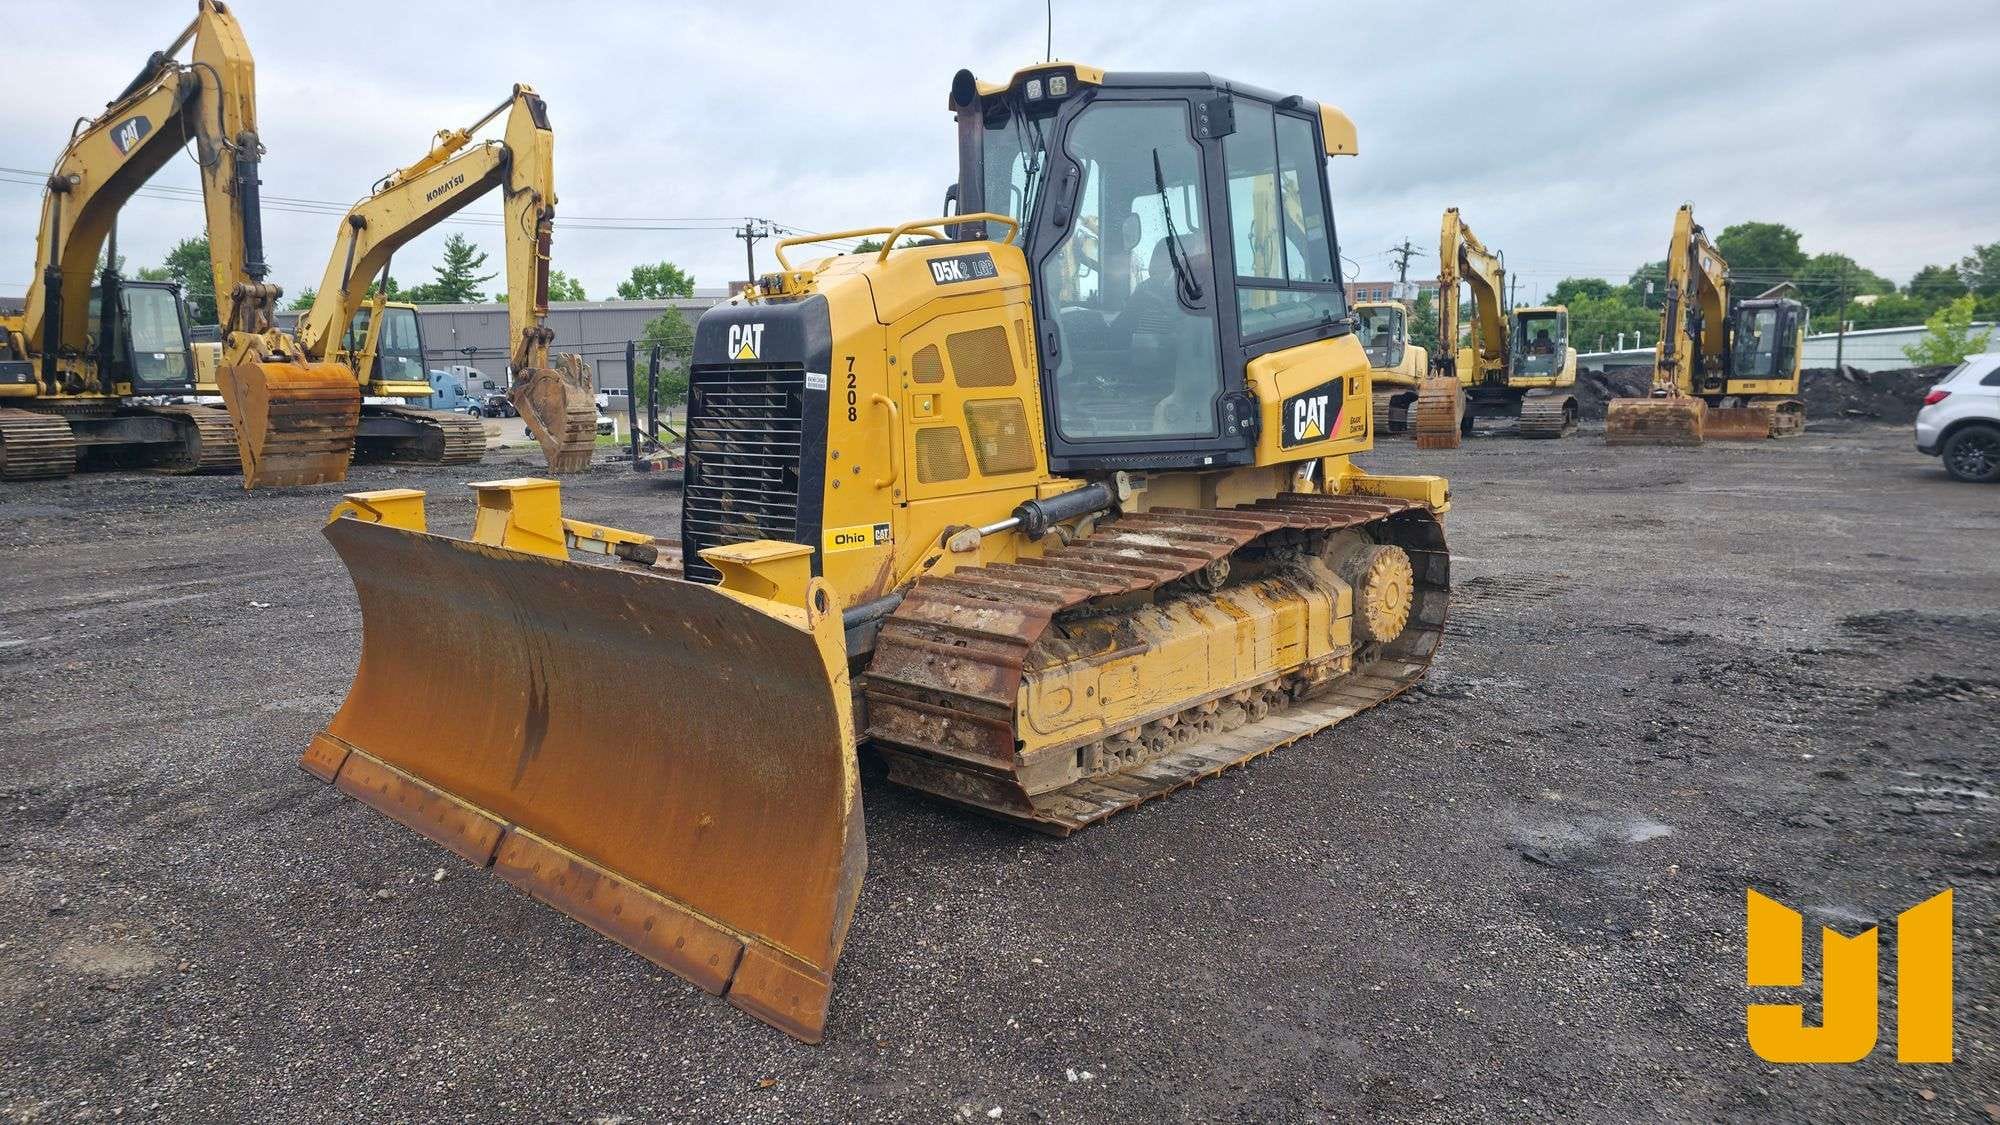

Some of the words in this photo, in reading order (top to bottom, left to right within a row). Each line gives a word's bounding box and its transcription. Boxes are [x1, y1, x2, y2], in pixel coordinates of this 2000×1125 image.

[121, 119, 139, 152] CAT
[426, 173, 465, 202] KOMATSU
[728, 323, 764, 360] CAT
[846, 356, 857, 422] 7208
[1294, 395, 1328, 440] CAT
[835, 533, 865, 545] Ohio
[875, 528, 889, 540] CAT
